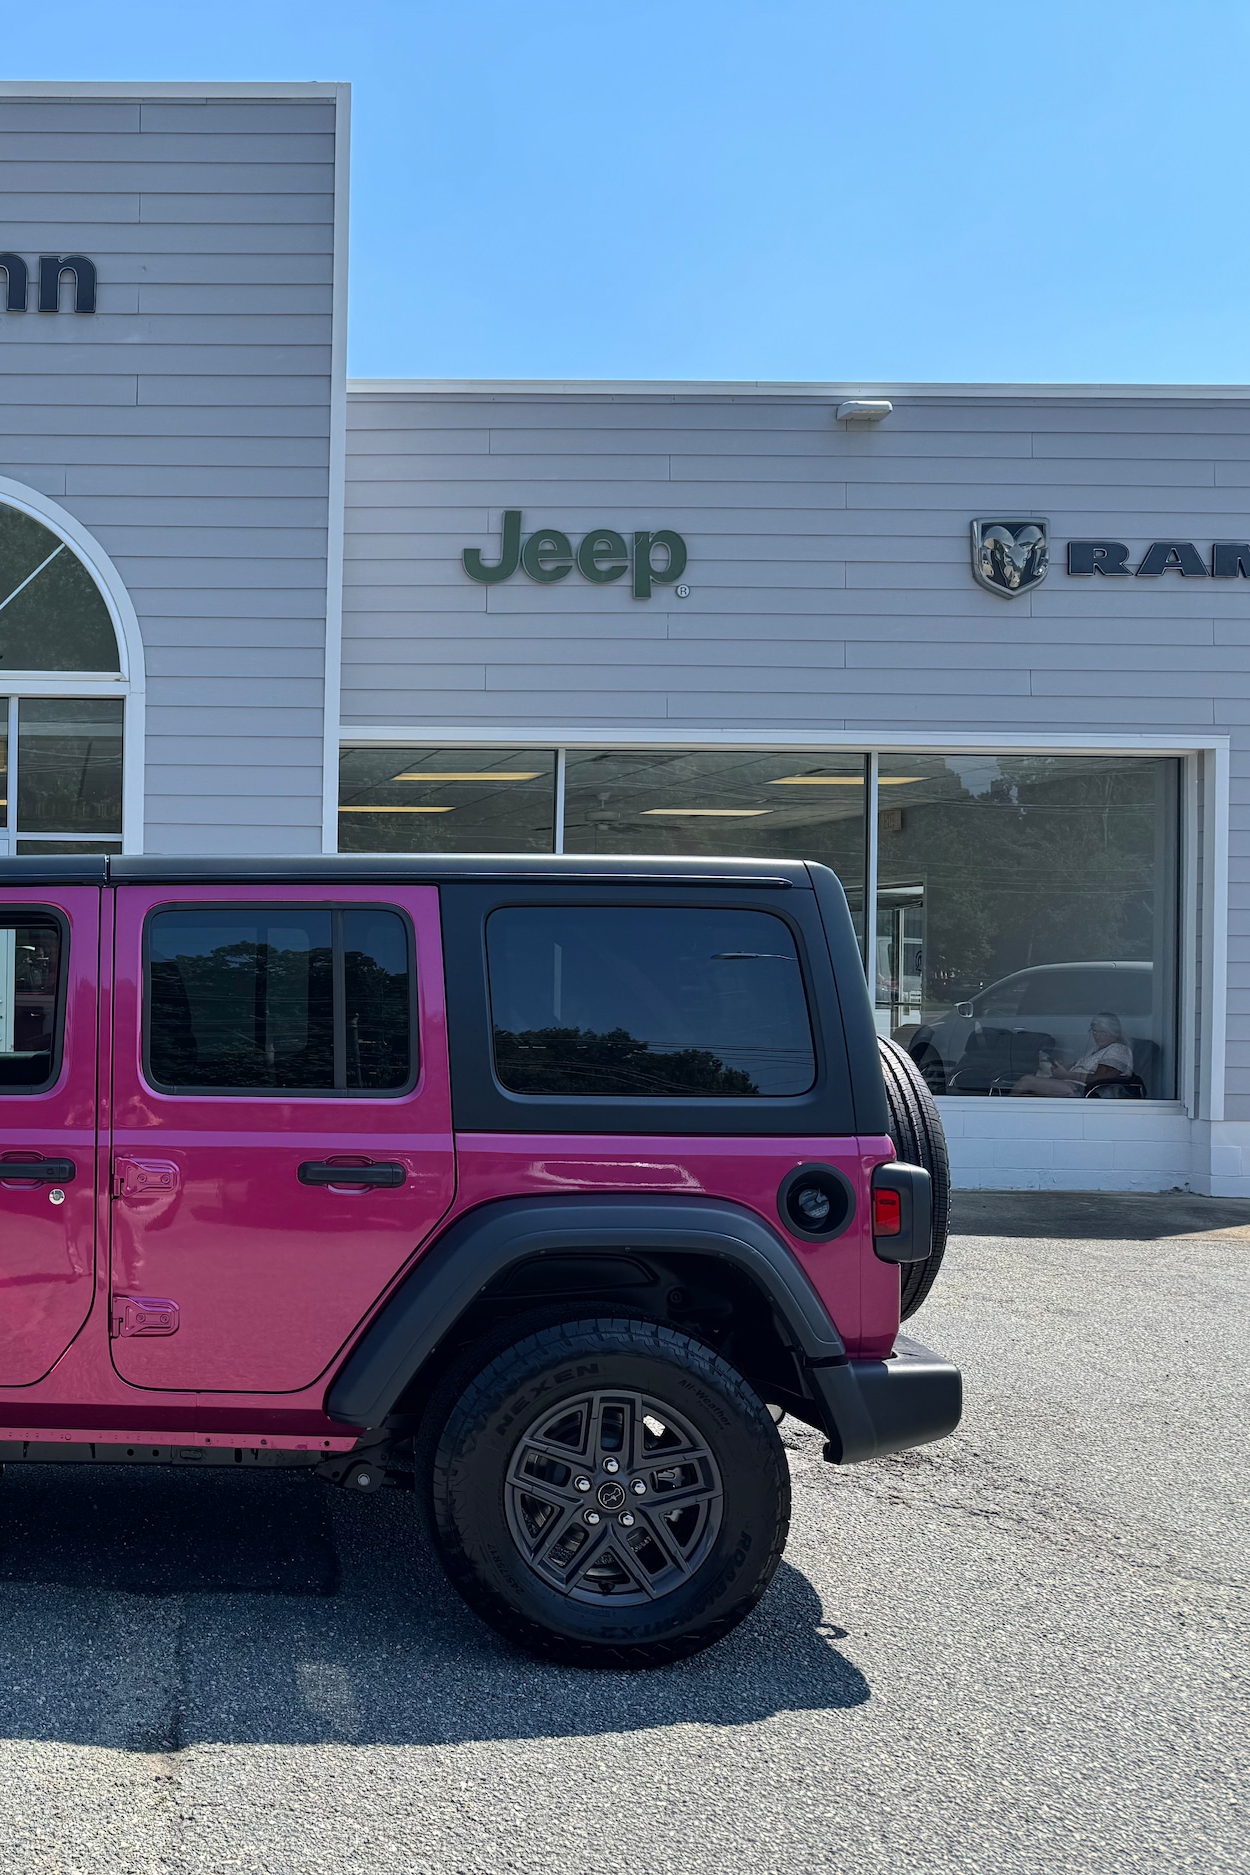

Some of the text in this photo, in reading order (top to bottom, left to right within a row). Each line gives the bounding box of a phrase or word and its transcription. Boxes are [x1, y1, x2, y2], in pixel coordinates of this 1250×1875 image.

[462, 510, 688, 600] Jeep
[495, 1362, 600, 1437] NEXEN
[678, 1379, 732, 1427] All-Weather
